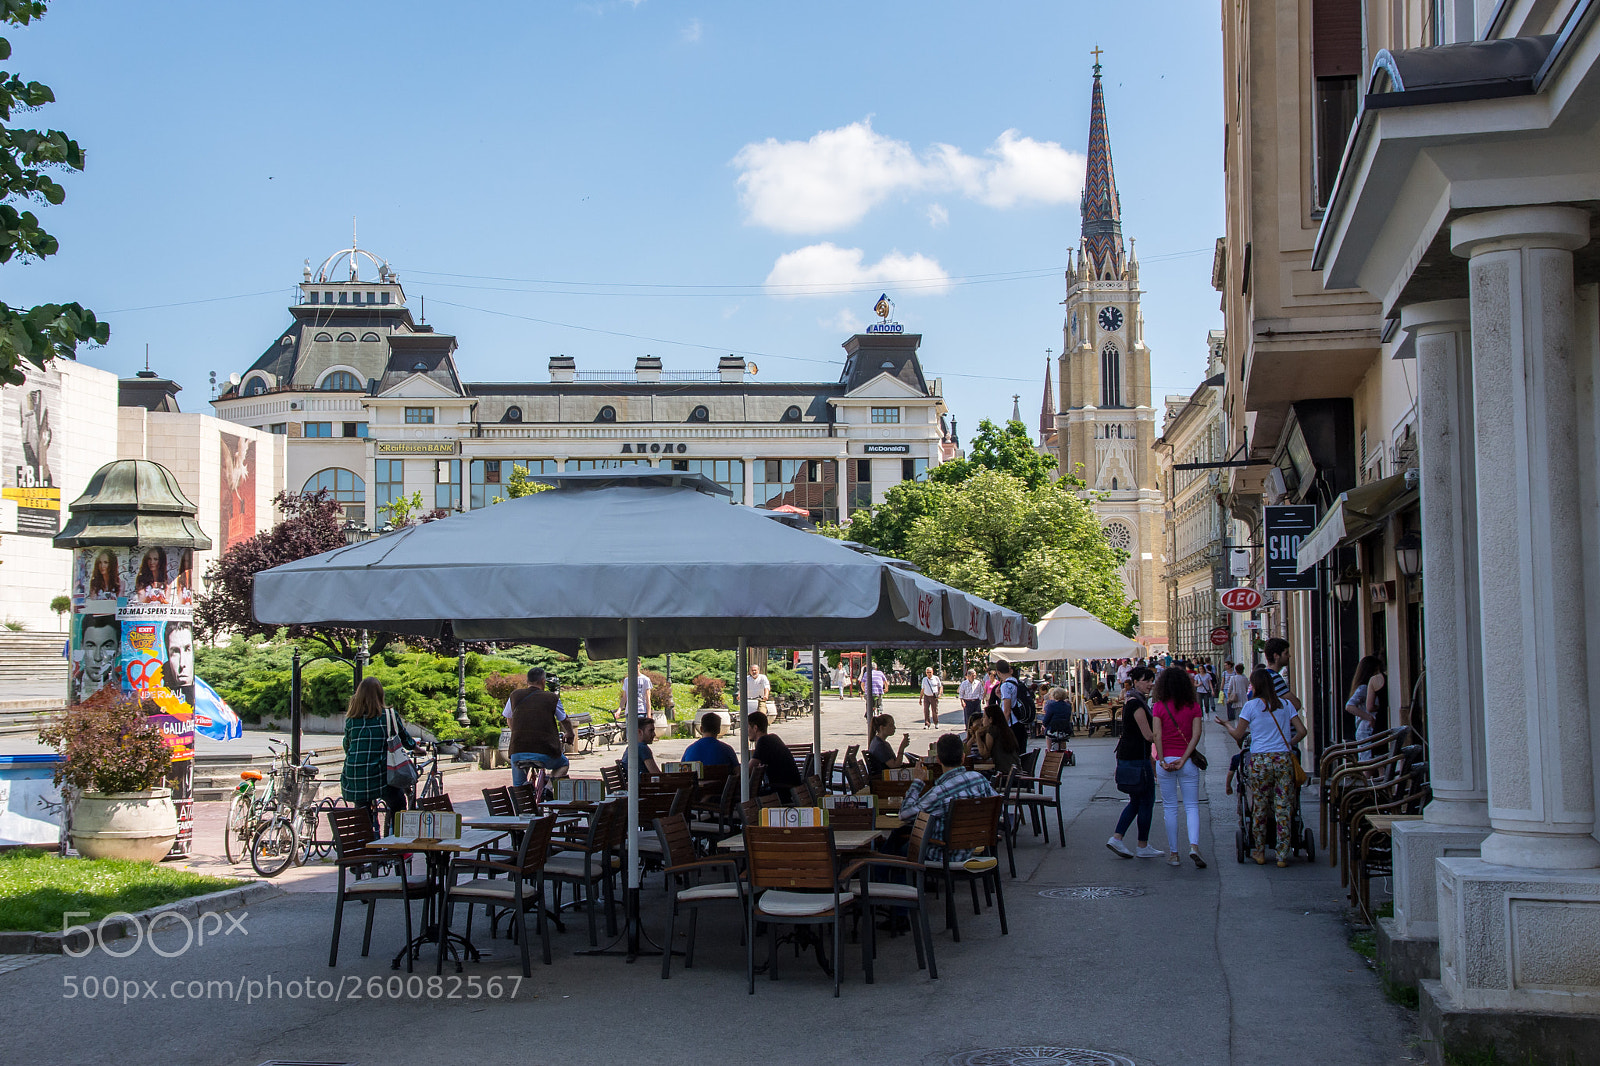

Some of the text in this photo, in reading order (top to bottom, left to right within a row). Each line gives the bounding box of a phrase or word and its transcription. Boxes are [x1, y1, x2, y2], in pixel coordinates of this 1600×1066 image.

[873, 324, 902, 332] АПОЛО
[386, 443, 453, 452] Raiffeisen BANK
[25, 499, 49, 508] TESLA
[1270, 535, 1308, 560] SHO
[1227, 592, 1257, 607] LEO
